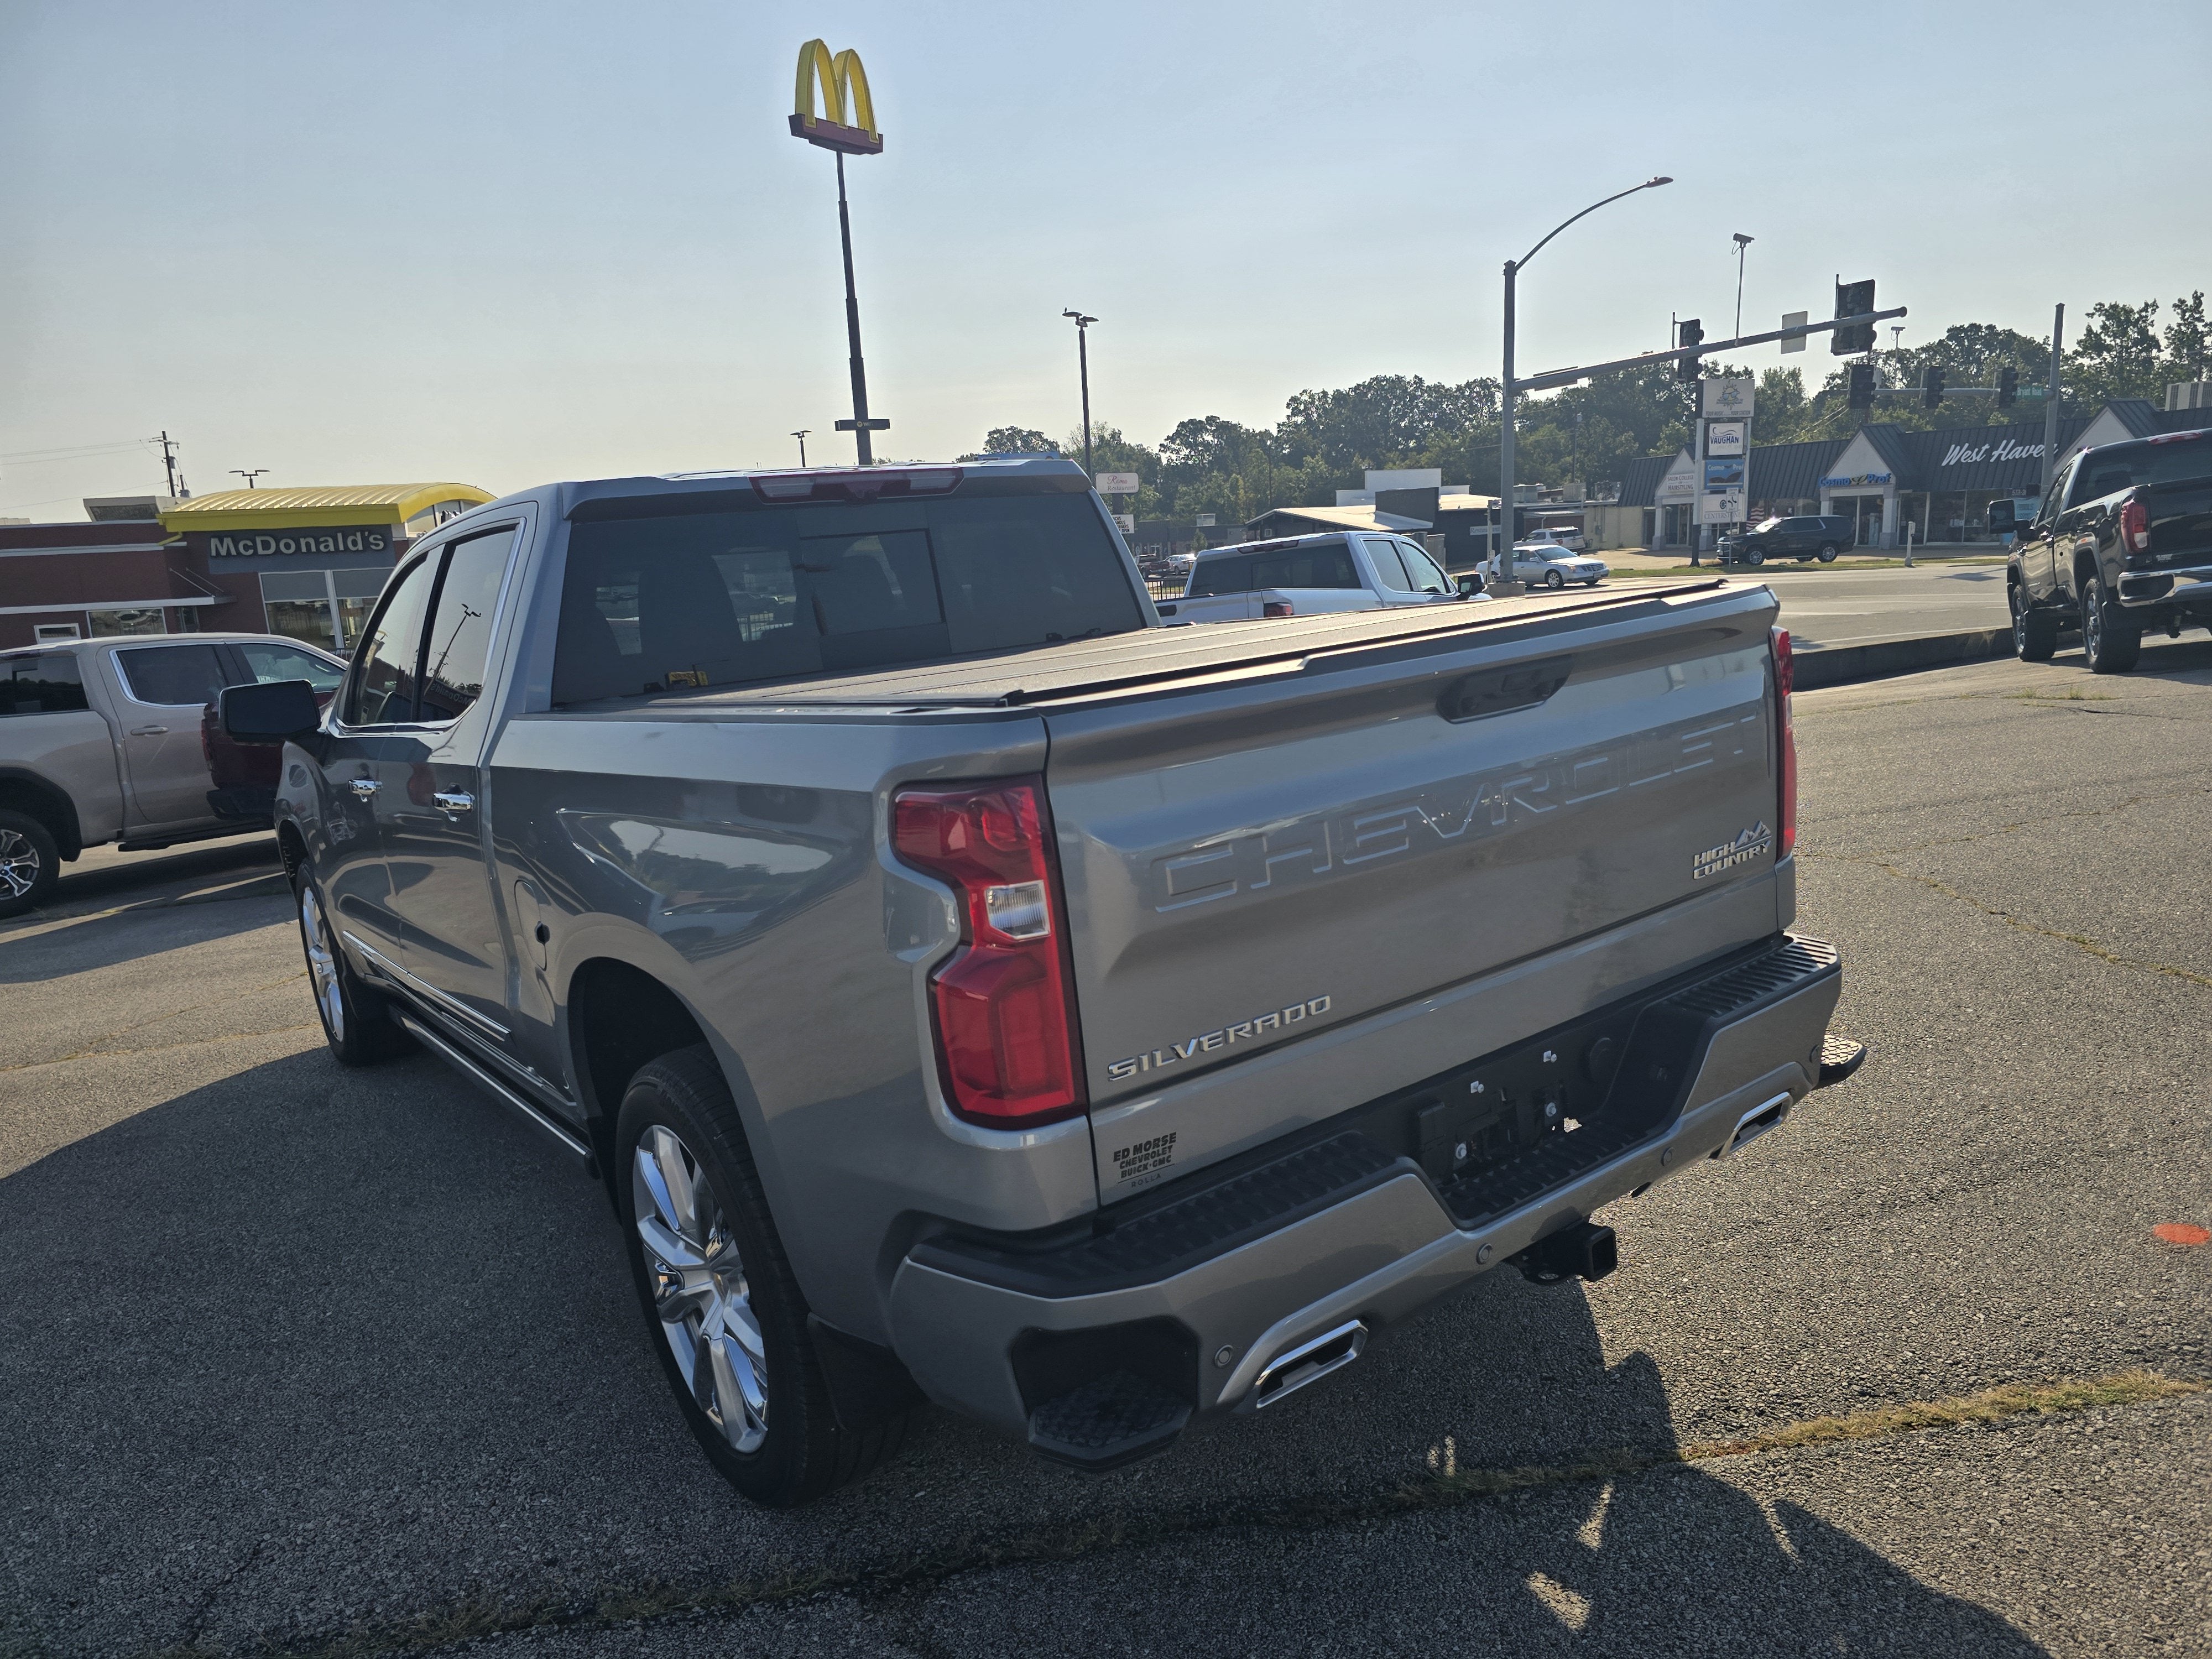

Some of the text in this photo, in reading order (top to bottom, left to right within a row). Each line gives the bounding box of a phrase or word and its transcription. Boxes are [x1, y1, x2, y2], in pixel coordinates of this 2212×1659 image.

[1710, 436, 1739, 444] VAUGHAN
[1941, 443, 1990, 466] West
[1818, 473, 1891, 487] Cosmo Prof
[210, 531, 384, 556] McDonald's
[1154, 713, 1757, 912] CHEVROLET
[1693, 840, 1771, 879] COUNTRY
[1694, 842, 1735, 867] HIGH
[1107, 995, 1331, 1081] SILVERADO
[1113, 1131, 1177, 1162] ED MORSE
[1119, 1145, 1173, 1169] CHEVROLET
[1131, 1173, 1161, 1188] ROLLA
